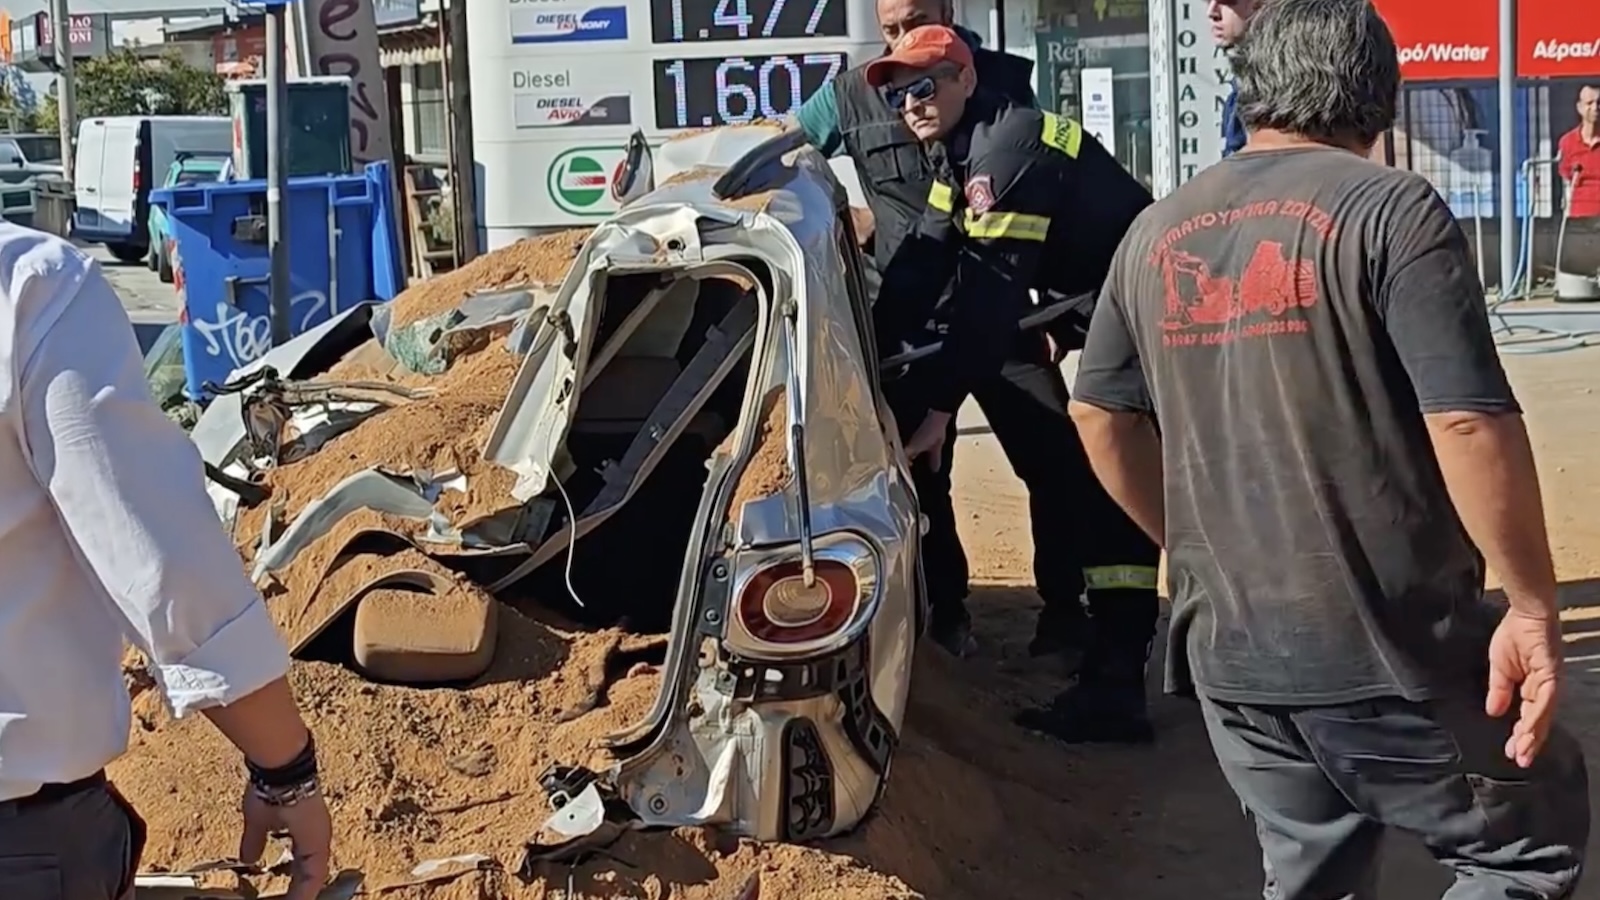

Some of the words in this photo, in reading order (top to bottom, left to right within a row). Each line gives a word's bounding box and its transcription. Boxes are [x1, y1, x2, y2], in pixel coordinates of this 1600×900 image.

[536, 13, 578, 24] DIESEL
[1395, 43, 1489, 66] ρό/Water
[513, 70, 570, 88] Diesel
[665, 54, 841, 126] 1.607
[536, 98, 583, 109] DIESEL
